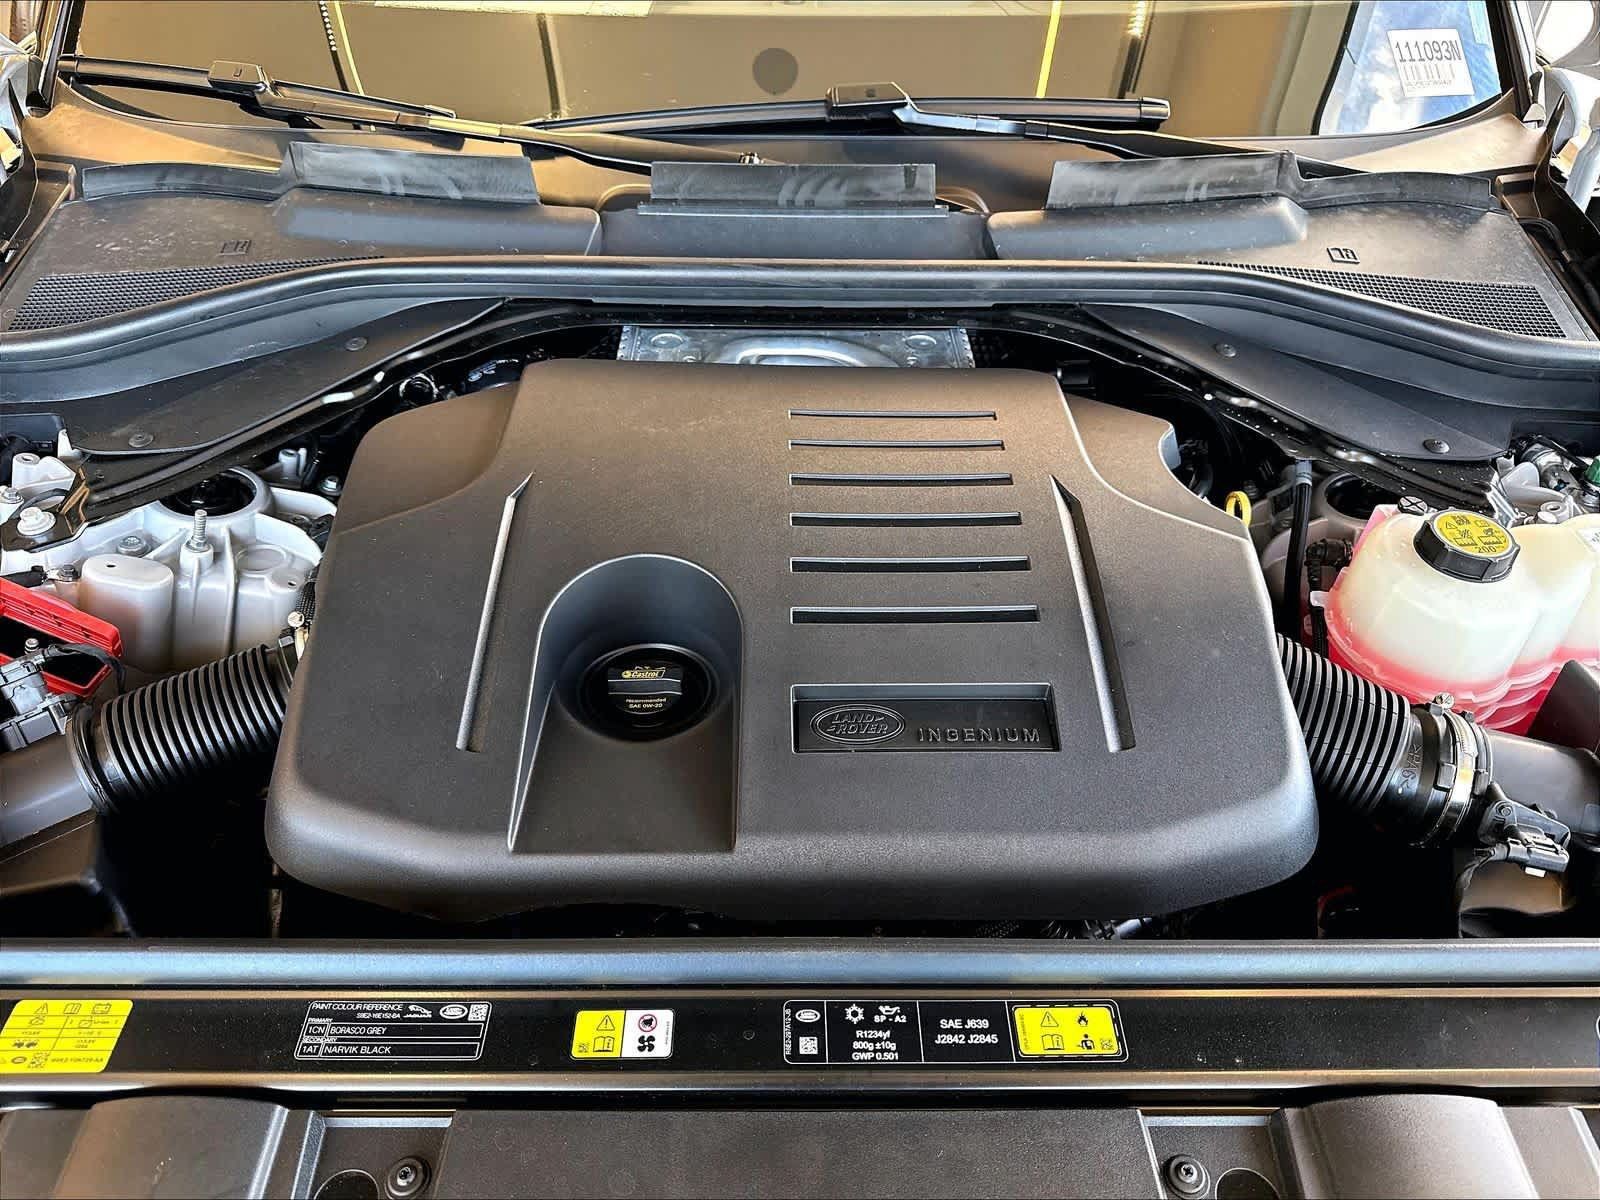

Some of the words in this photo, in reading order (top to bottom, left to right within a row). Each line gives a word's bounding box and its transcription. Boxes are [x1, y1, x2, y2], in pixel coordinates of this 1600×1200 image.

[1395, 39, 1463, 63] 111093N
[631, 670, 659, 679] Castrol
[831, 713, 877, 724] LAND
[835, 722, 889, 735] ROVER
[918, 727, 1041, 743] INGENIUM
[332, 1003, 362, 1011] COLOUR
[362, 1003, 404, 1011] REFERENCE
[873, 1015, 887, 1023] SP
[894, 1015, 907, 1023] A2
[939, 1019, 963, 1029] SAE
[964, 1019, 990, 1029] J639
[308, 1026, 326, 1034] 1CN
[329, 1026, 366, 1035] BORASCO
[366, 1026, 388, 1035] GREY
[856, 1030, 891, 1040] R1234yf
[934, 1034, 966, 1044] J2842
[967, 1034, 999, 1044] J2845
[302, 1046, 319, 1054] 1AT
[323, 1046, 359, 1054] NARVIK
[360, 1046, 392, 1055] BLACK
[852, 1041, 874, 1051] 800g
[875, 1041, 897, 1051] ±10g
[852, 1052, 874, 1060] GWP
[875, 1052, 899, 1060] 0.501
